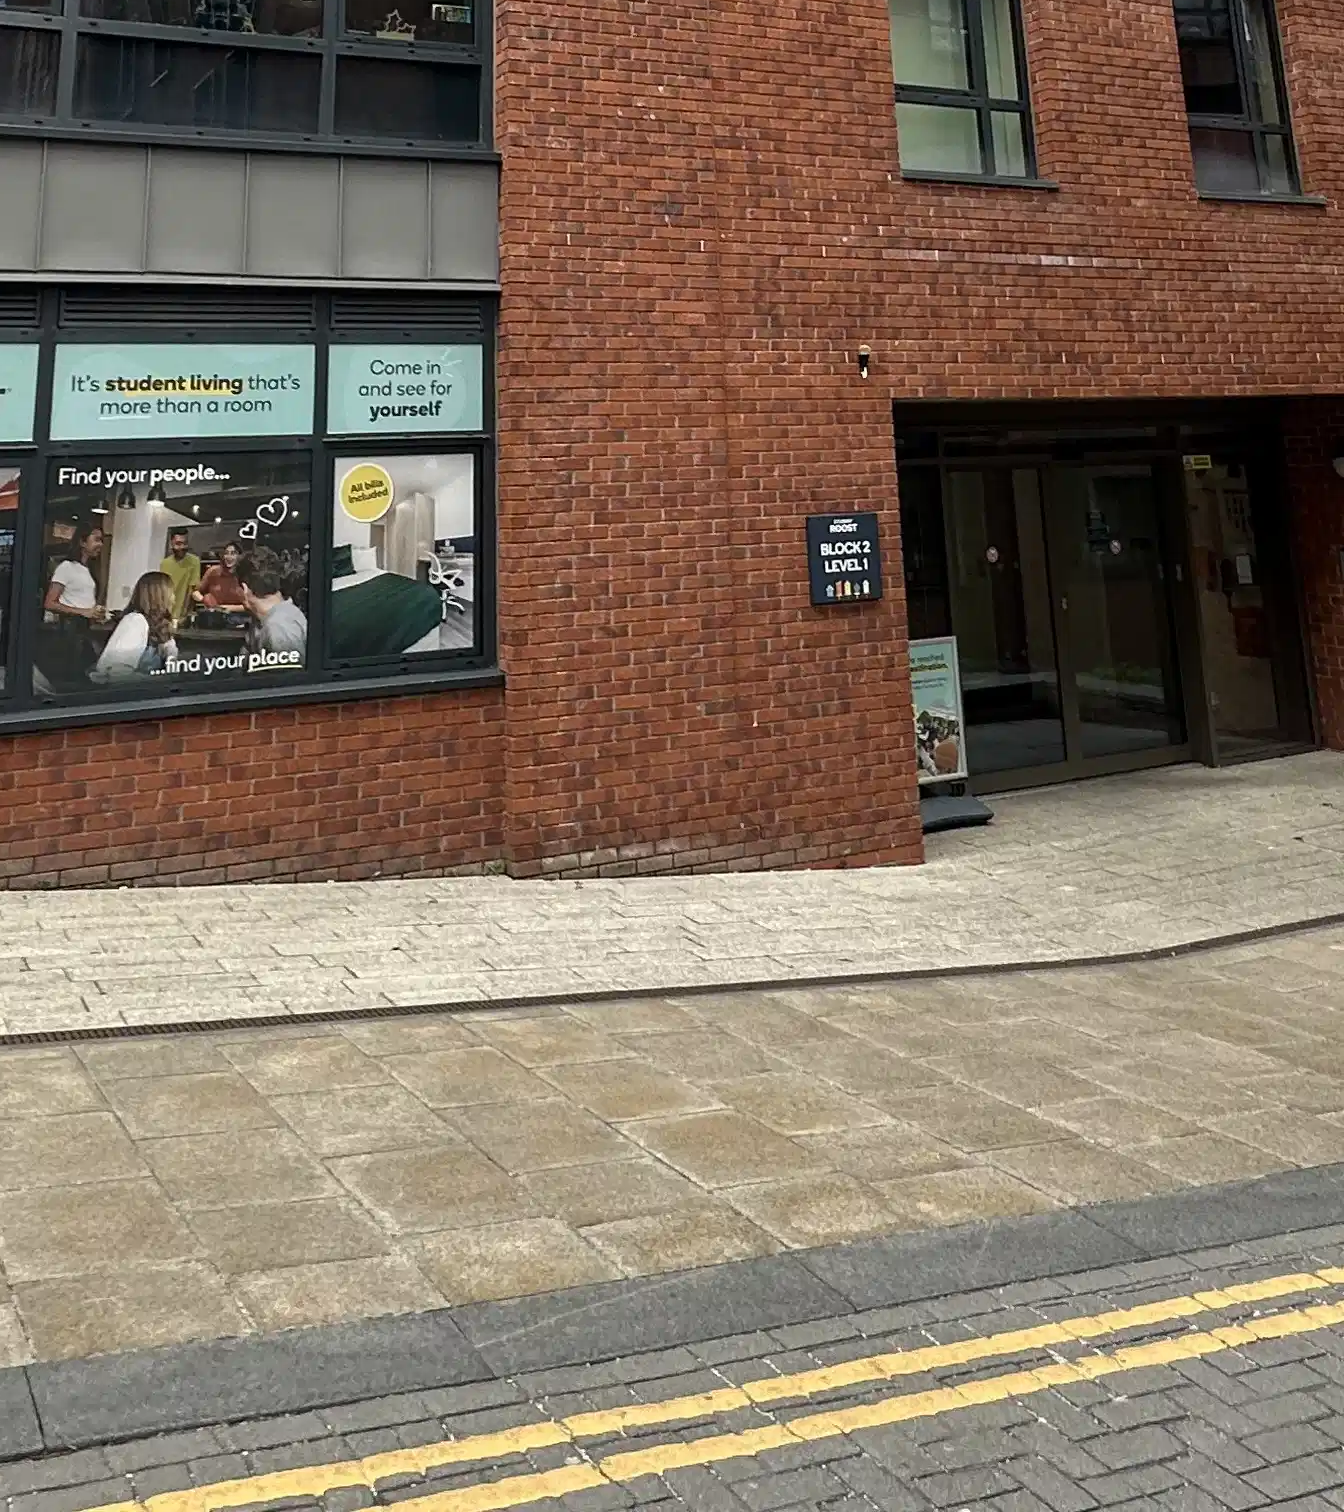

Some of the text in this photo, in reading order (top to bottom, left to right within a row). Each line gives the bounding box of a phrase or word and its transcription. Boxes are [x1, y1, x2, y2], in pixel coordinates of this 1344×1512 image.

[370, 360, 441, 375] Come in
[71, 374, 300, 395] It's student living that's
[358, 380, 453, 396] and see for
[100, 397, 272, 415] more than a room
[368, 400, 443, 422] yourself
[58, 467, 101, 485] Find
[104, 469, 148, 488] your
[351, 482, 363, 493] All
[829, 523, 858, 533] ROOST
[820, 540, 871, 556] BLOCK 2
[824, 557, 869, 573] LEVEL 1
[204, 654, 246, 675] your
[249, 649, 300, 671] place
